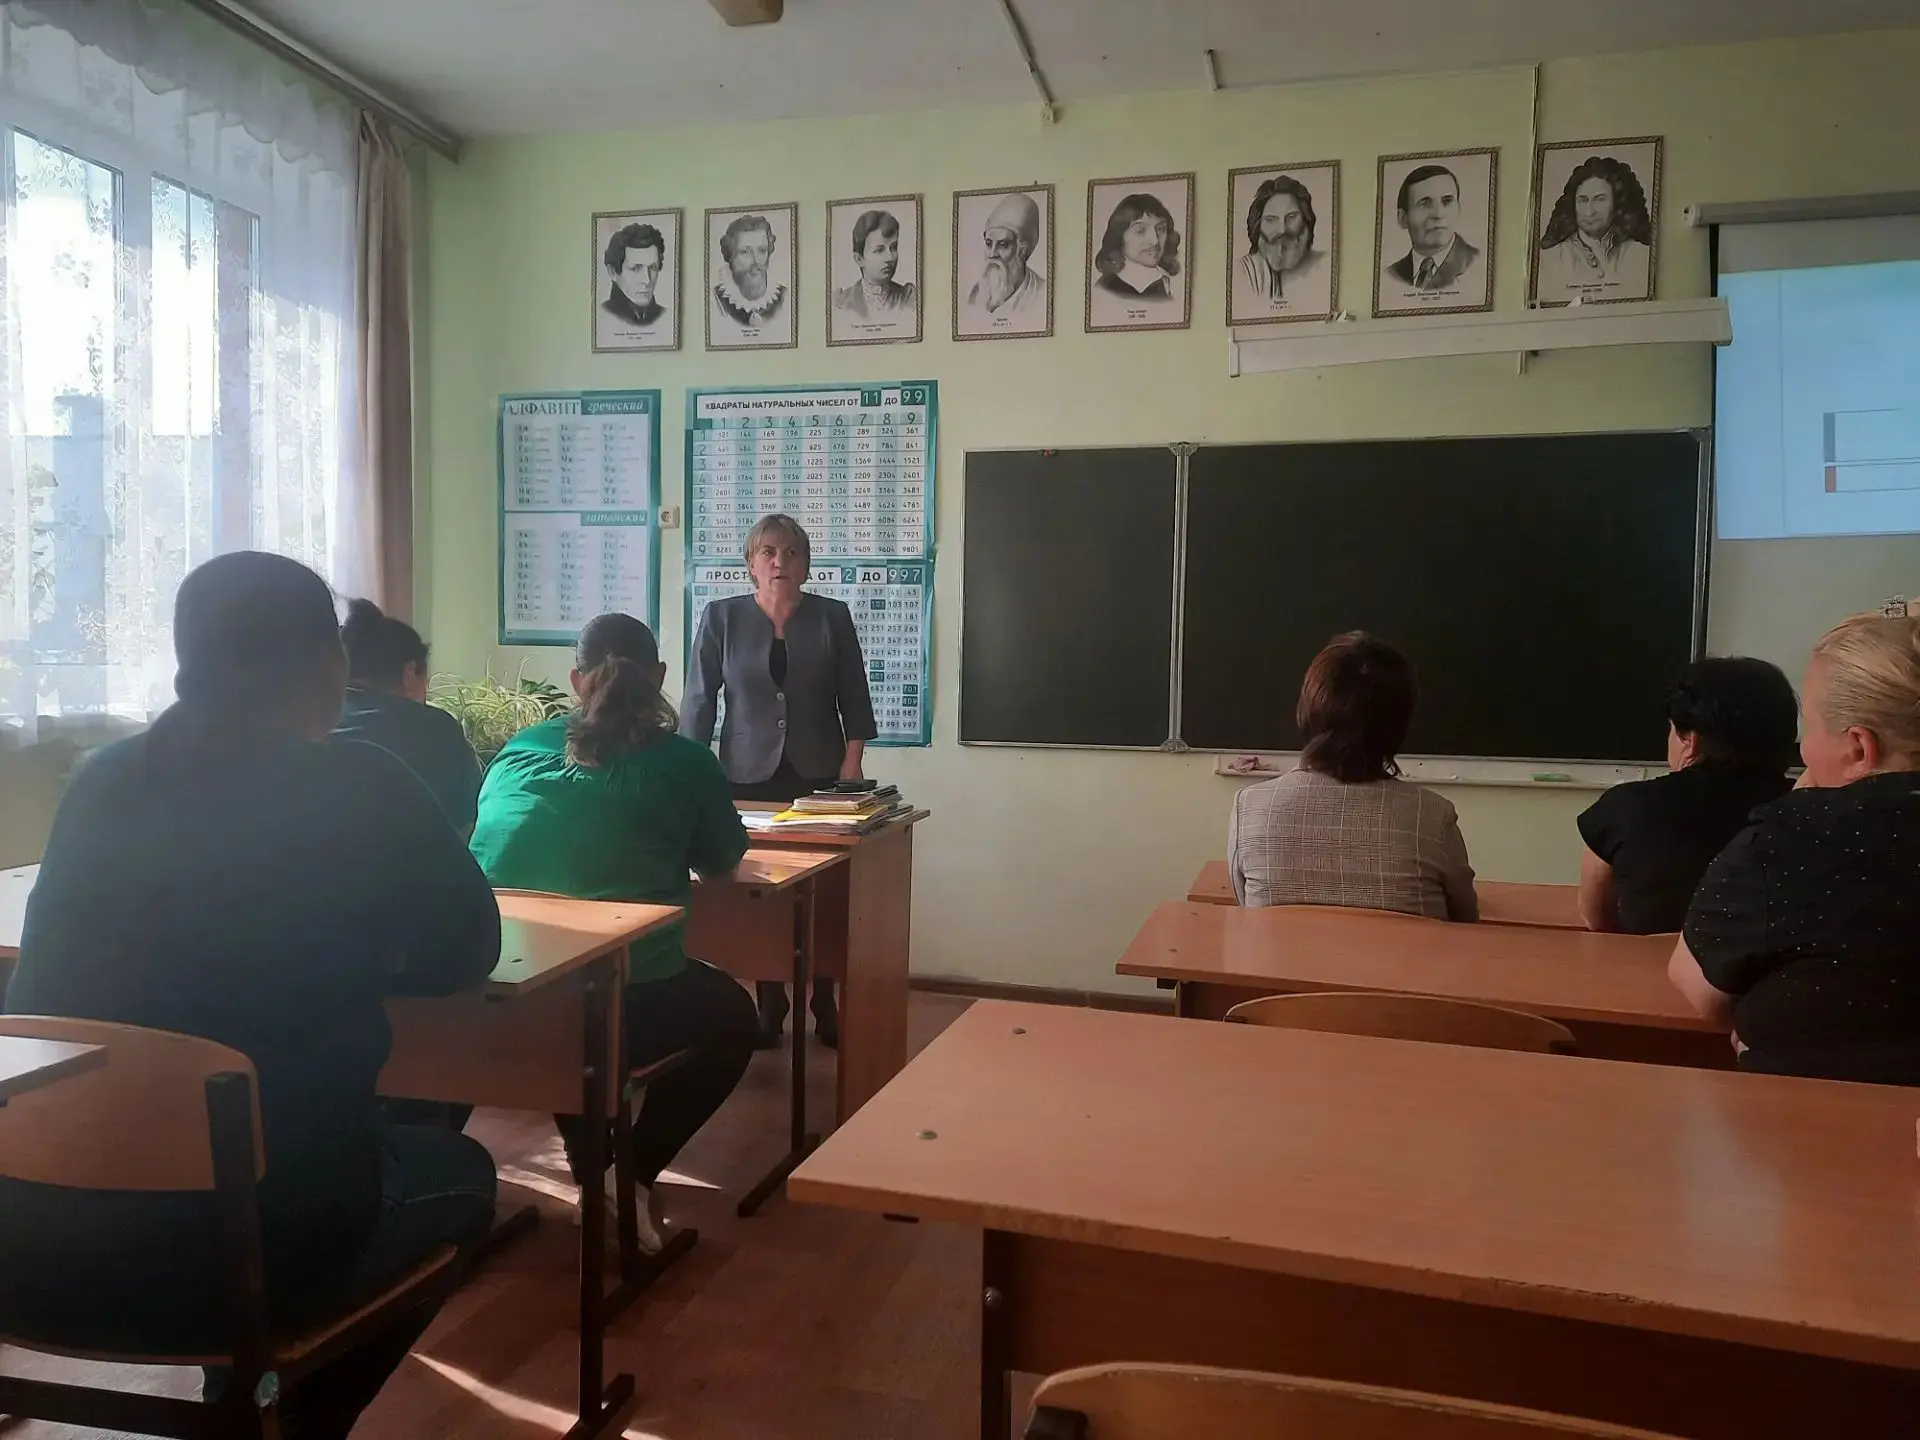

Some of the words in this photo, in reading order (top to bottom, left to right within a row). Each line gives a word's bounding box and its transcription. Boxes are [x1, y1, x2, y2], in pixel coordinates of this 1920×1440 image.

[705, 401, 750, 410] КВАДРАТЫ
[752, 400, 814, 409] НАТУРАЛЬНЫХ
[816, 398, 845, 407] ЧИСЕЛ
[847, 398, 859, 406] ОТ
[862, 391, 879, 404] 11
[884, 397, 898, 405] ДО
[902, 390, 923, 403] 99
[507, 402, 579, 415] АЛФАВИТ
[587, 400, 643, 413] греческий
[721, 417, 726, 429] 1
[742, 417, 750, 428] 2
[764, 416, 773, 428] 3
[788, 415, 796, 427] 4
[812, 414, 819, 427] 5
[835, 414, 843, 426] 6
[858, 413, 867, 425] 7
[883, 413, 891, 425] 8
[907, 412, 916, 424] 9
[698, 502, 706, 513] 6
[698, 530, 706, 542] 8
[698, 544, 706, 556] 9
[705, 571, 748, 580] ПРОСТ
[818, 571, 834, 580] ОТ
[845, 568, 853, 582] 2
[862, 572, 881, 582] ДО
[889, 569, 920, 582] 997
